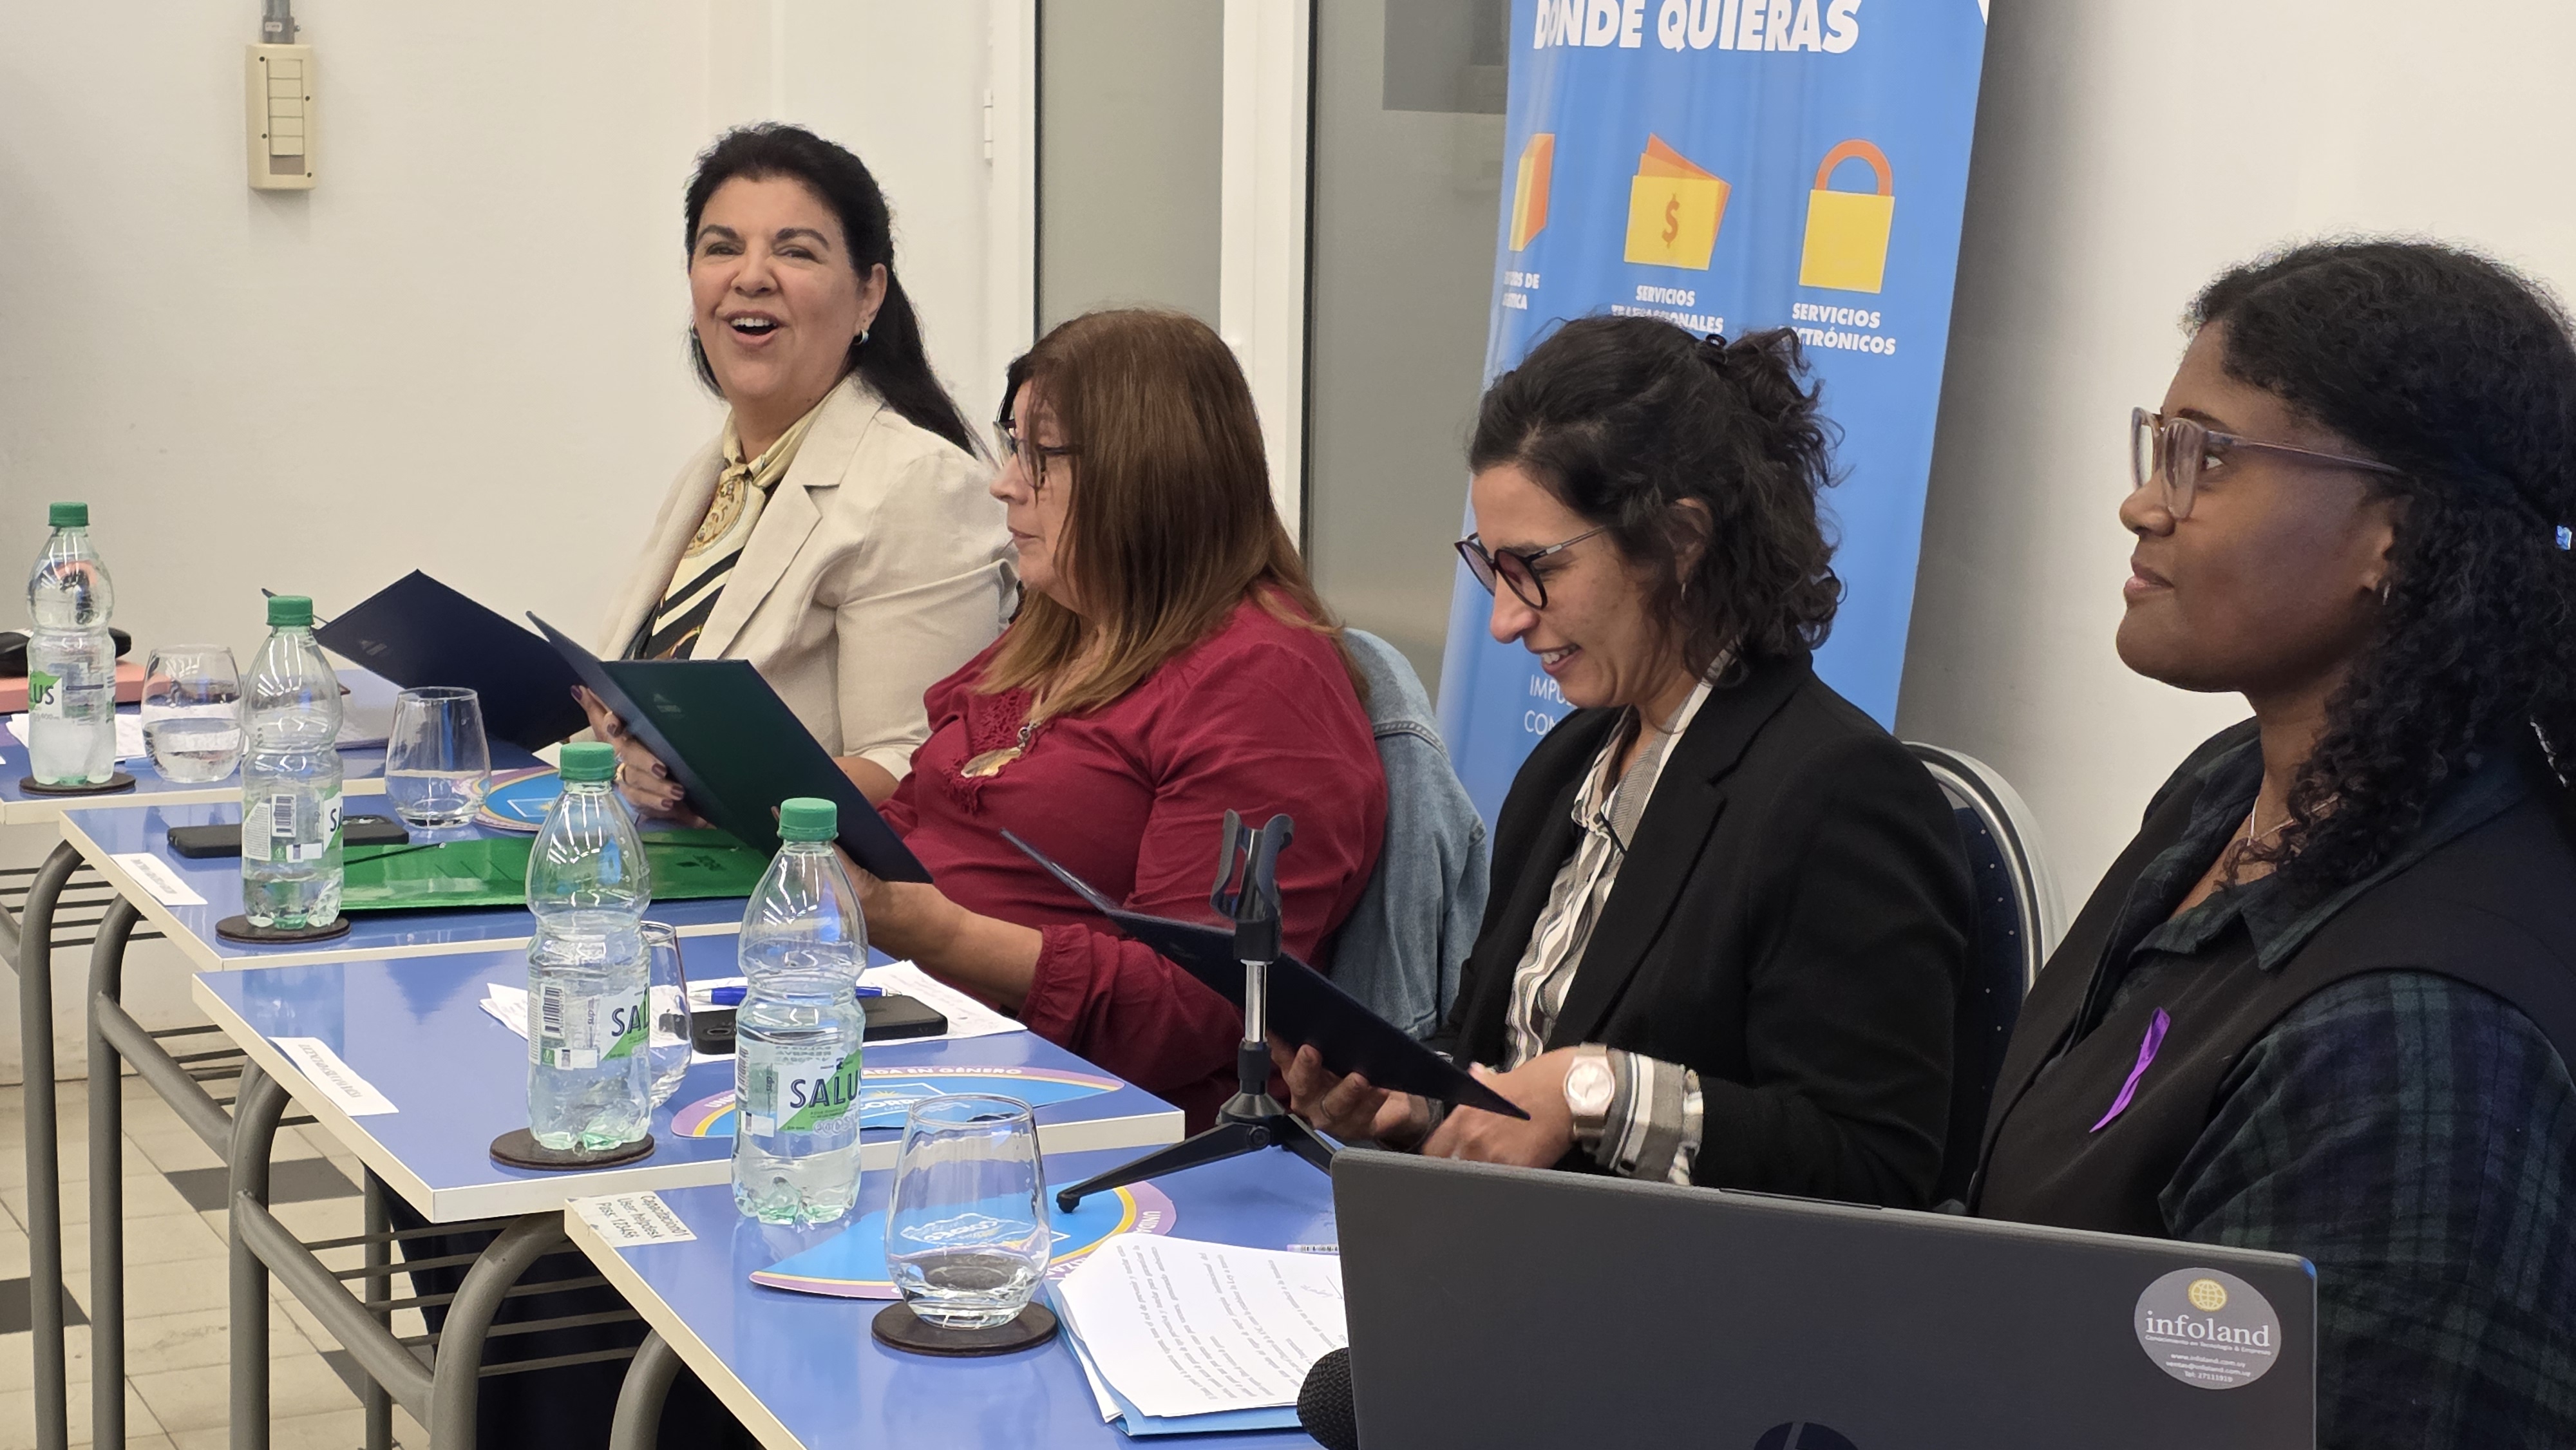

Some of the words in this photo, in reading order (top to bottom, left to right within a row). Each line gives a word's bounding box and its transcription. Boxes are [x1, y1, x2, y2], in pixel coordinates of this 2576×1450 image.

[1658, 0, 1861, 53] QUIERAS
[1524, 272, 1540, 289] DE
[1636, 285, 1695, 307] SERVICIOS
[1792, 303, 1880, 328] SERVICIOS
[1778, 325, 1896, 355] CTRÓNICOS
[1530, 674, 1573, 706] IMPU
[611, 1000, 650, 1037] SAL
[790, 1068, 862, 1109] SALU
[1133, 1210, 1162, 1234] UNIDA
[2145, 1310, 2270, 1347] infoland
